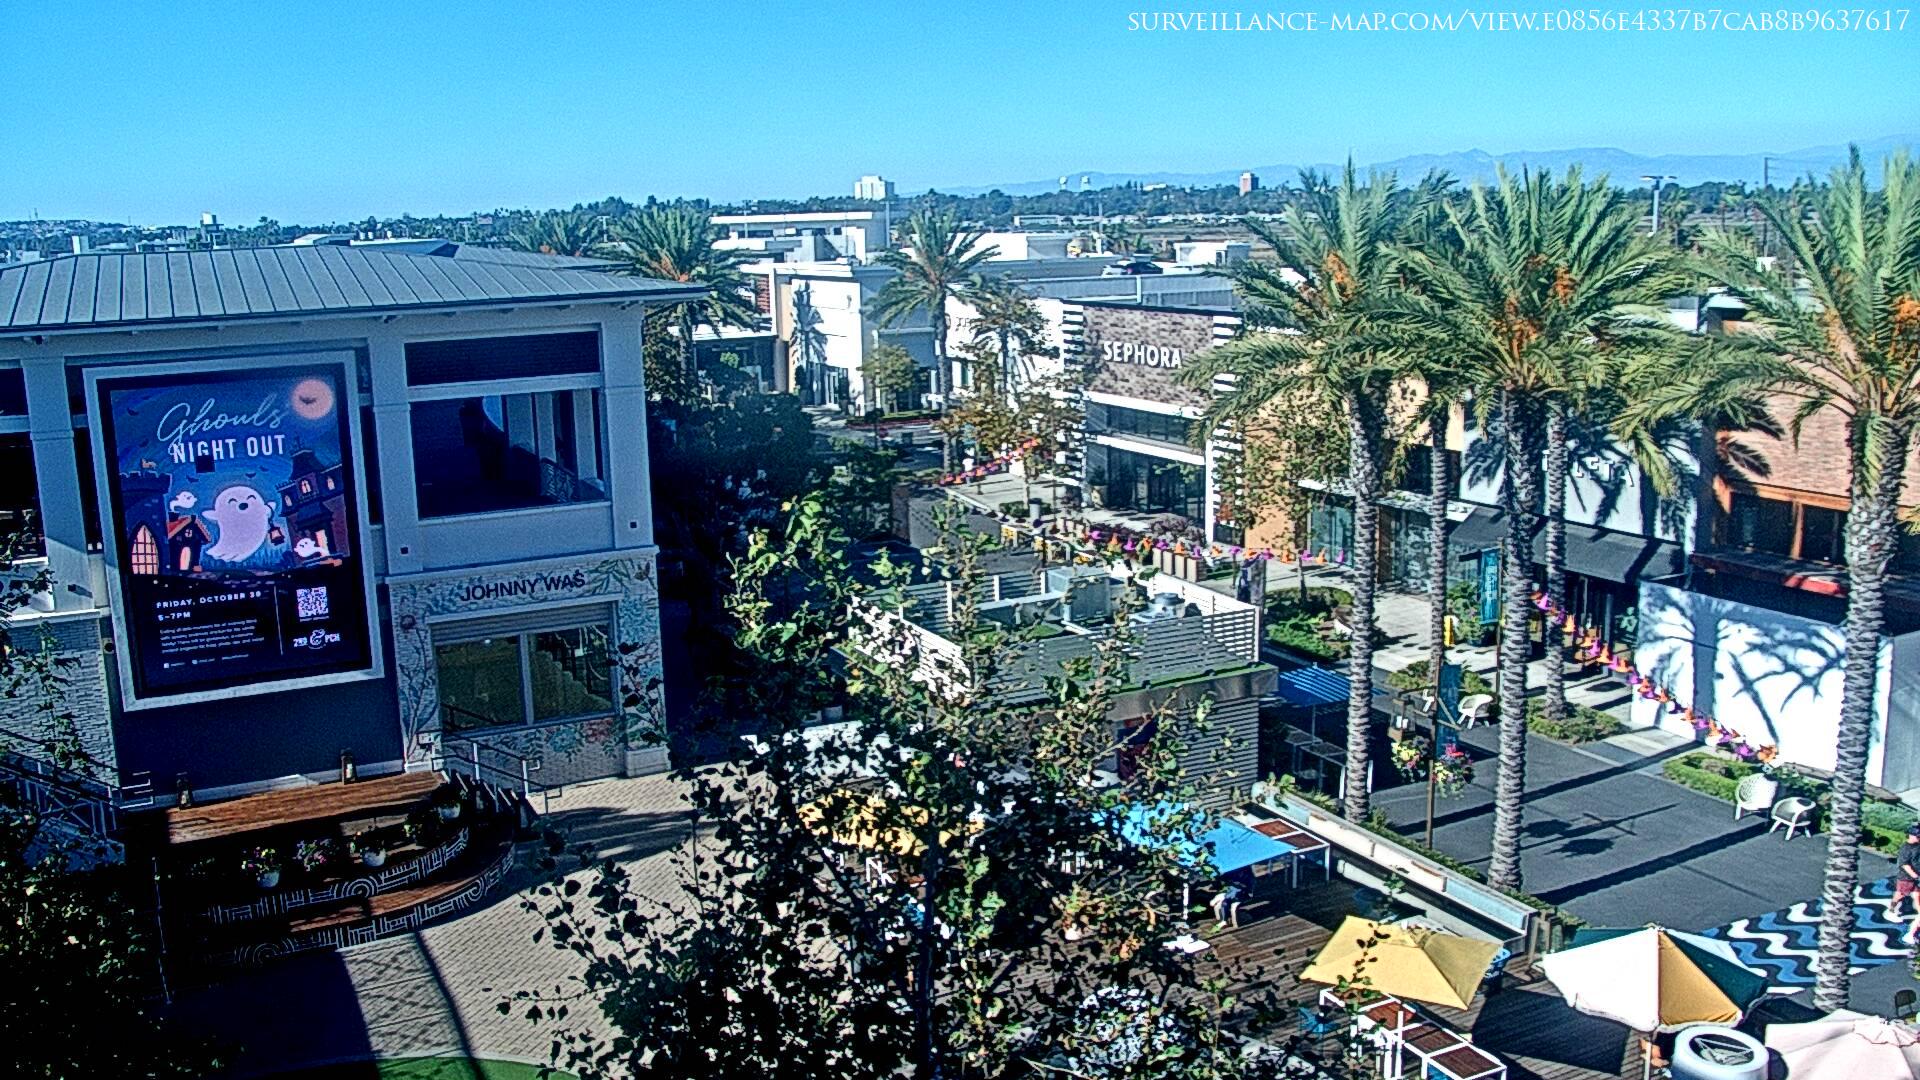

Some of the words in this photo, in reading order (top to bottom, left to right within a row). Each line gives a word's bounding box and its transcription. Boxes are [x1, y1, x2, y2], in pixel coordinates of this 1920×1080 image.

[1103, 341, 1182, 369] SEPHORA
[157, 394, 288, 455] Ghouls
[173, 438, 236, 464] NIGHT
[246, 434, 286, 458] OUT
[156, 599, 196, 609] FRIDAY,
[199, 592, 246, 604] OCTOBER
[460, 578, 539, 601] JOHNNY
[543, 571, 586, 591] WAS
